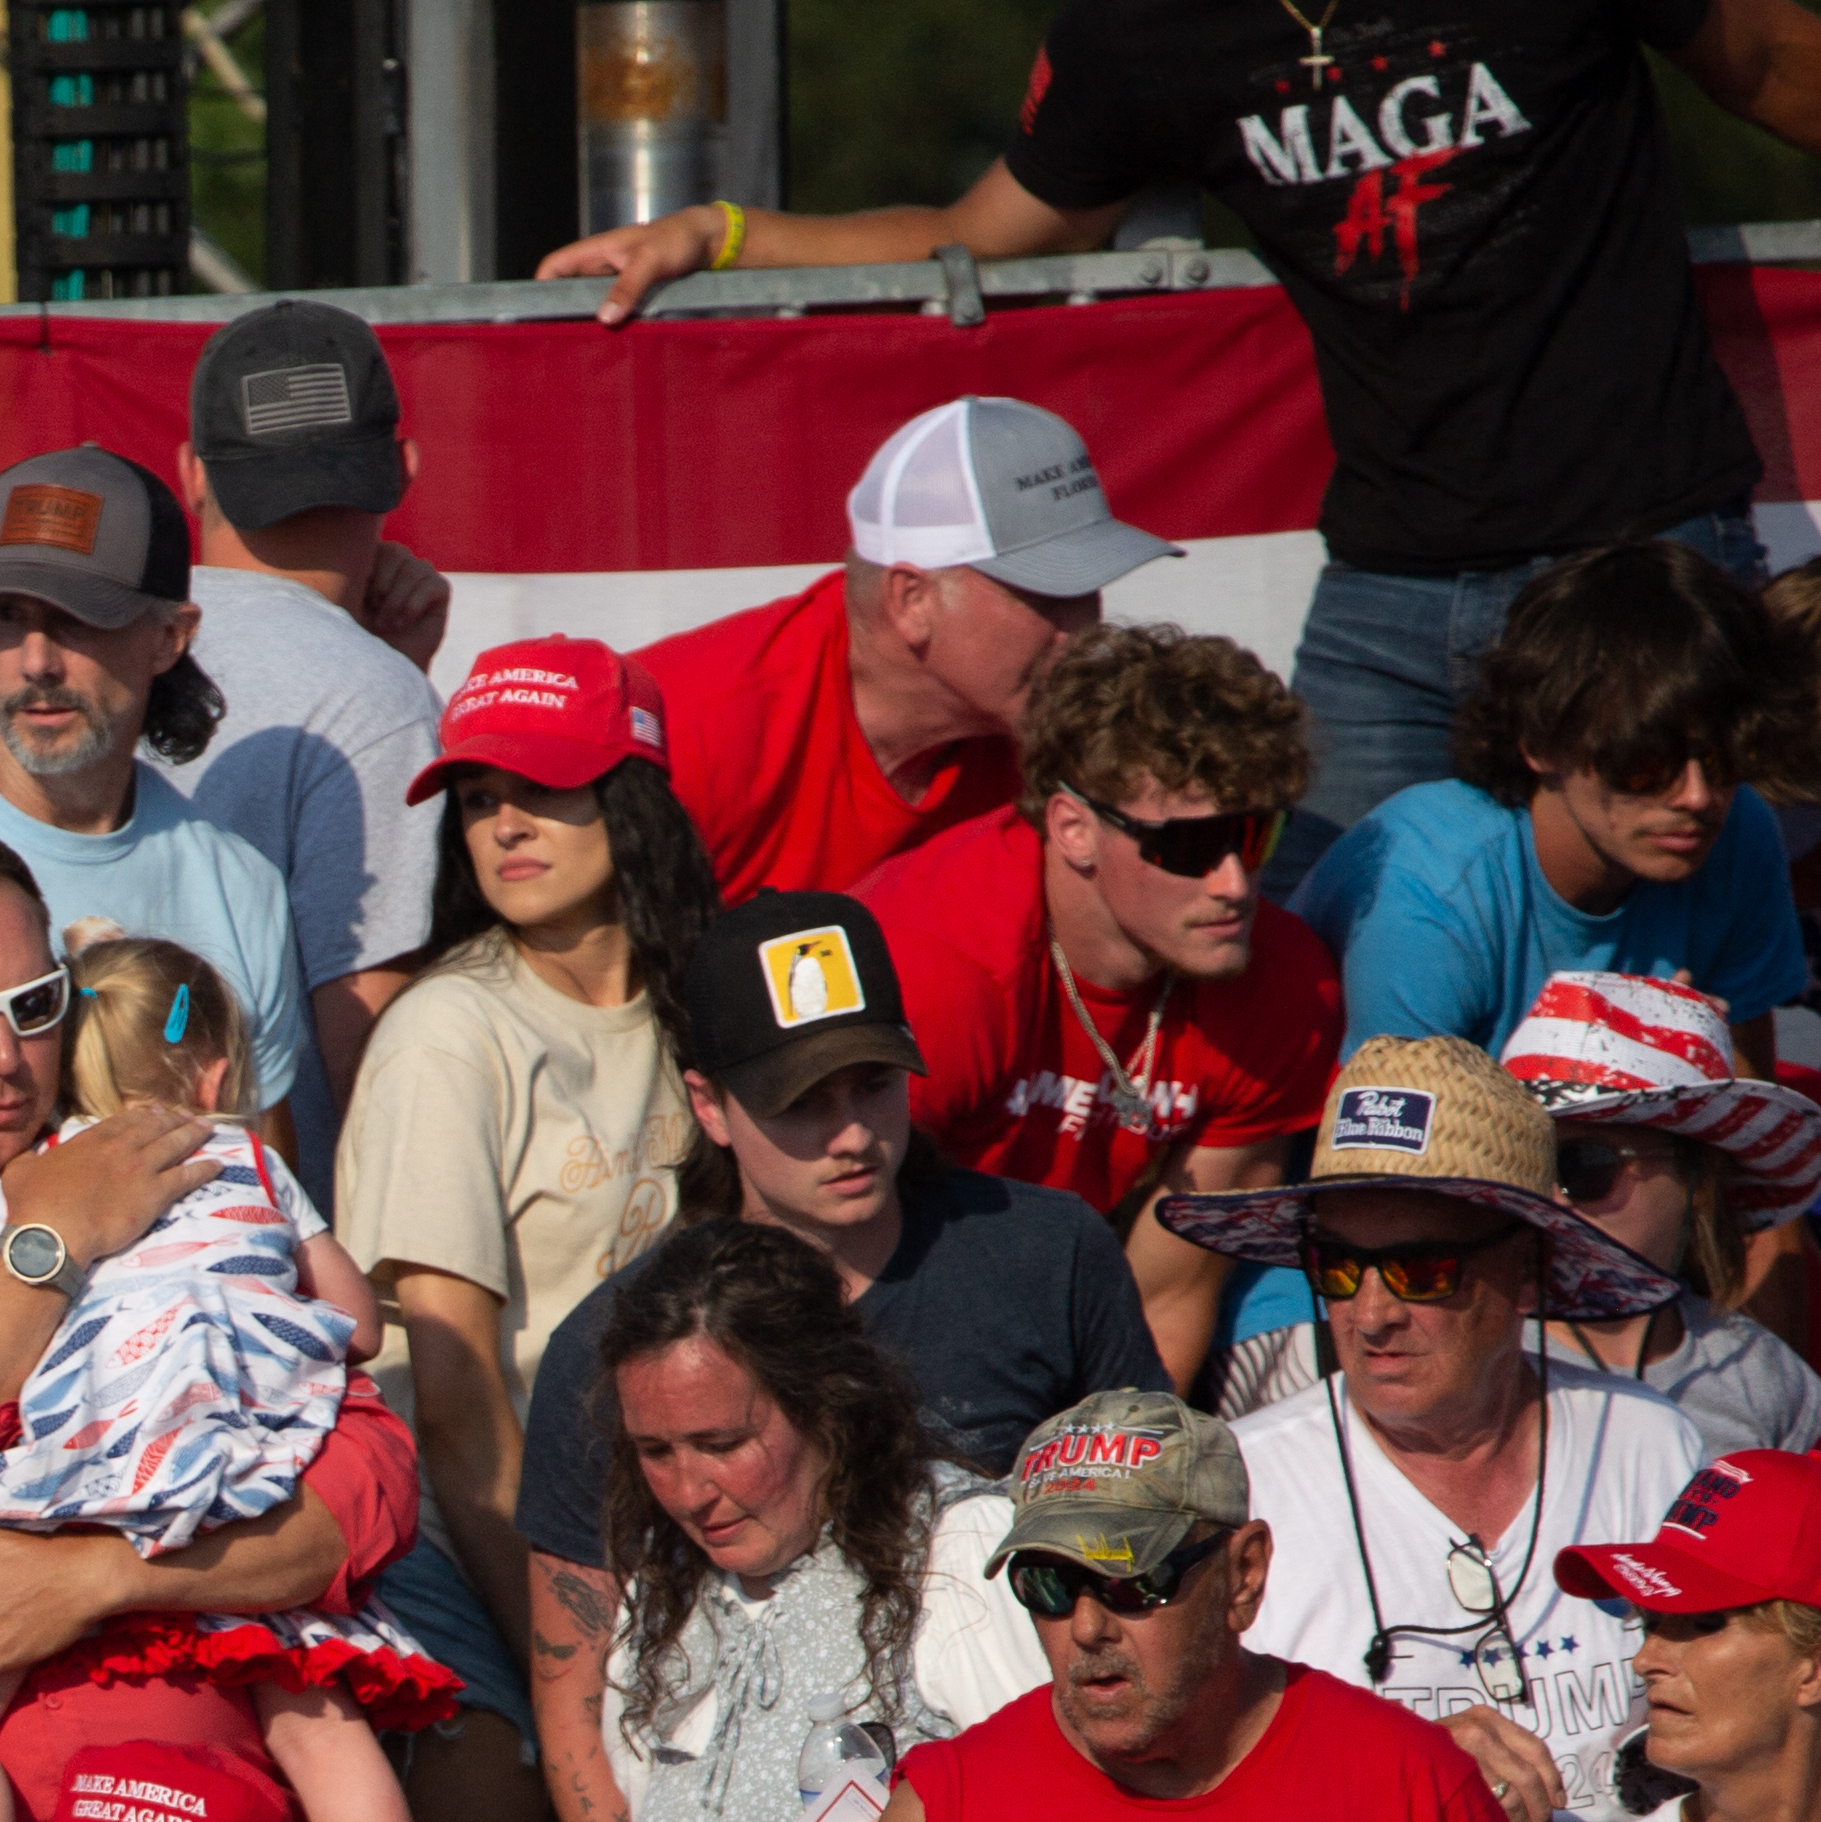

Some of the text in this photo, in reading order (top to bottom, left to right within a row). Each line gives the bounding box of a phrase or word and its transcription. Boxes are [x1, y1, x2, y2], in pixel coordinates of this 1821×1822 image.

[1236, 62, 1532, 186] MAGA
[1332, 148, 1455, 312] AF
[488, 667, 579, 691] AMERICA
[499, 688, 567, 709] AGAIN
[1368, 1116, 1424, 1142] Ribbon
[1020, 1432, 1161, 1484] TRUMP
[1044, 1477, 1096, 1496] 2024
[70, 1774, 207, 1817] MAKE AMERICA
[72, 1799, 125, 1821] GREAT
